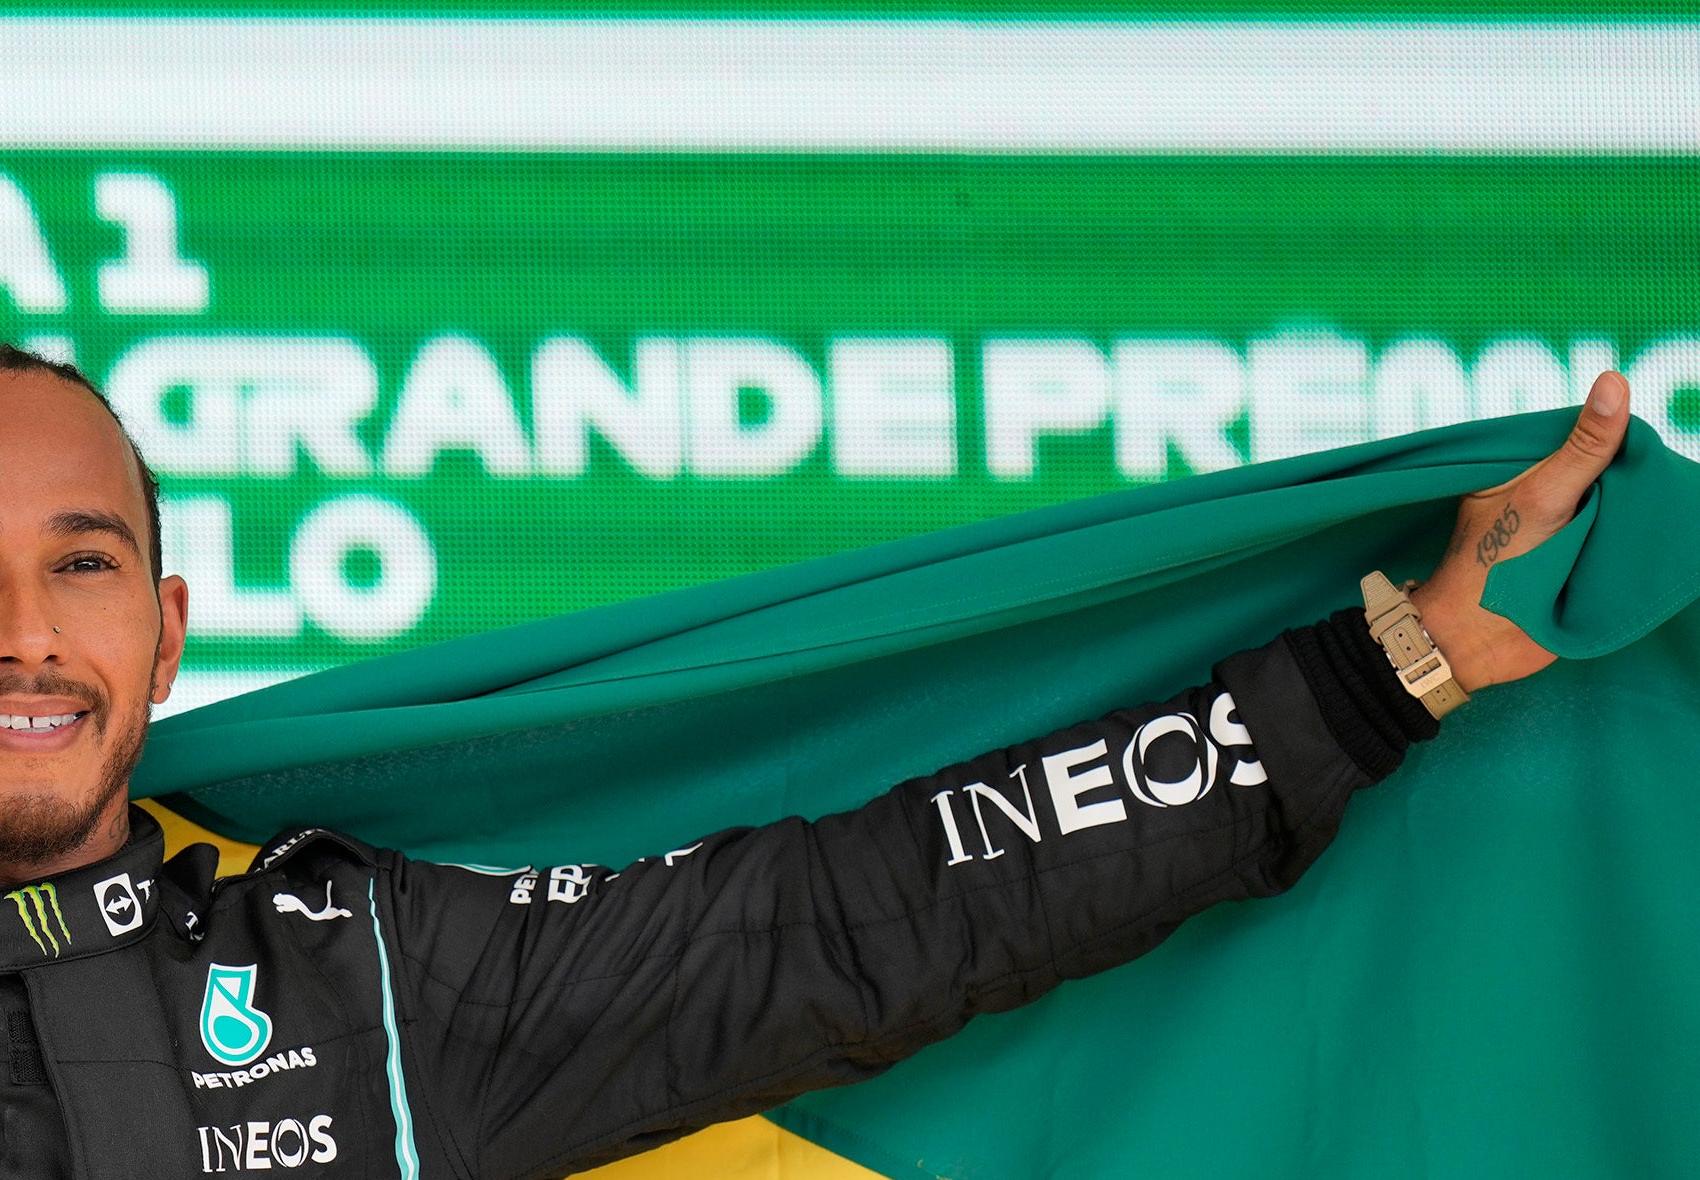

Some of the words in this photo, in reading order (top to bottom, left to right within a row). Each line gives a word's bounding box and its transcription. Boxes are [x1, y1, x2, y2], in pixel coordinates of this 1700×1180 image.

[93, 170, 210, 316] 1
[105, 333, 958, 480] GRANDE
[1475, 502, 1521, 568] 1985
[930, 690, 1269, 867] INEOS
[191, 1047, 318, 1090] PETRONAS
[197, 1114, 338, 1173] INEOS
